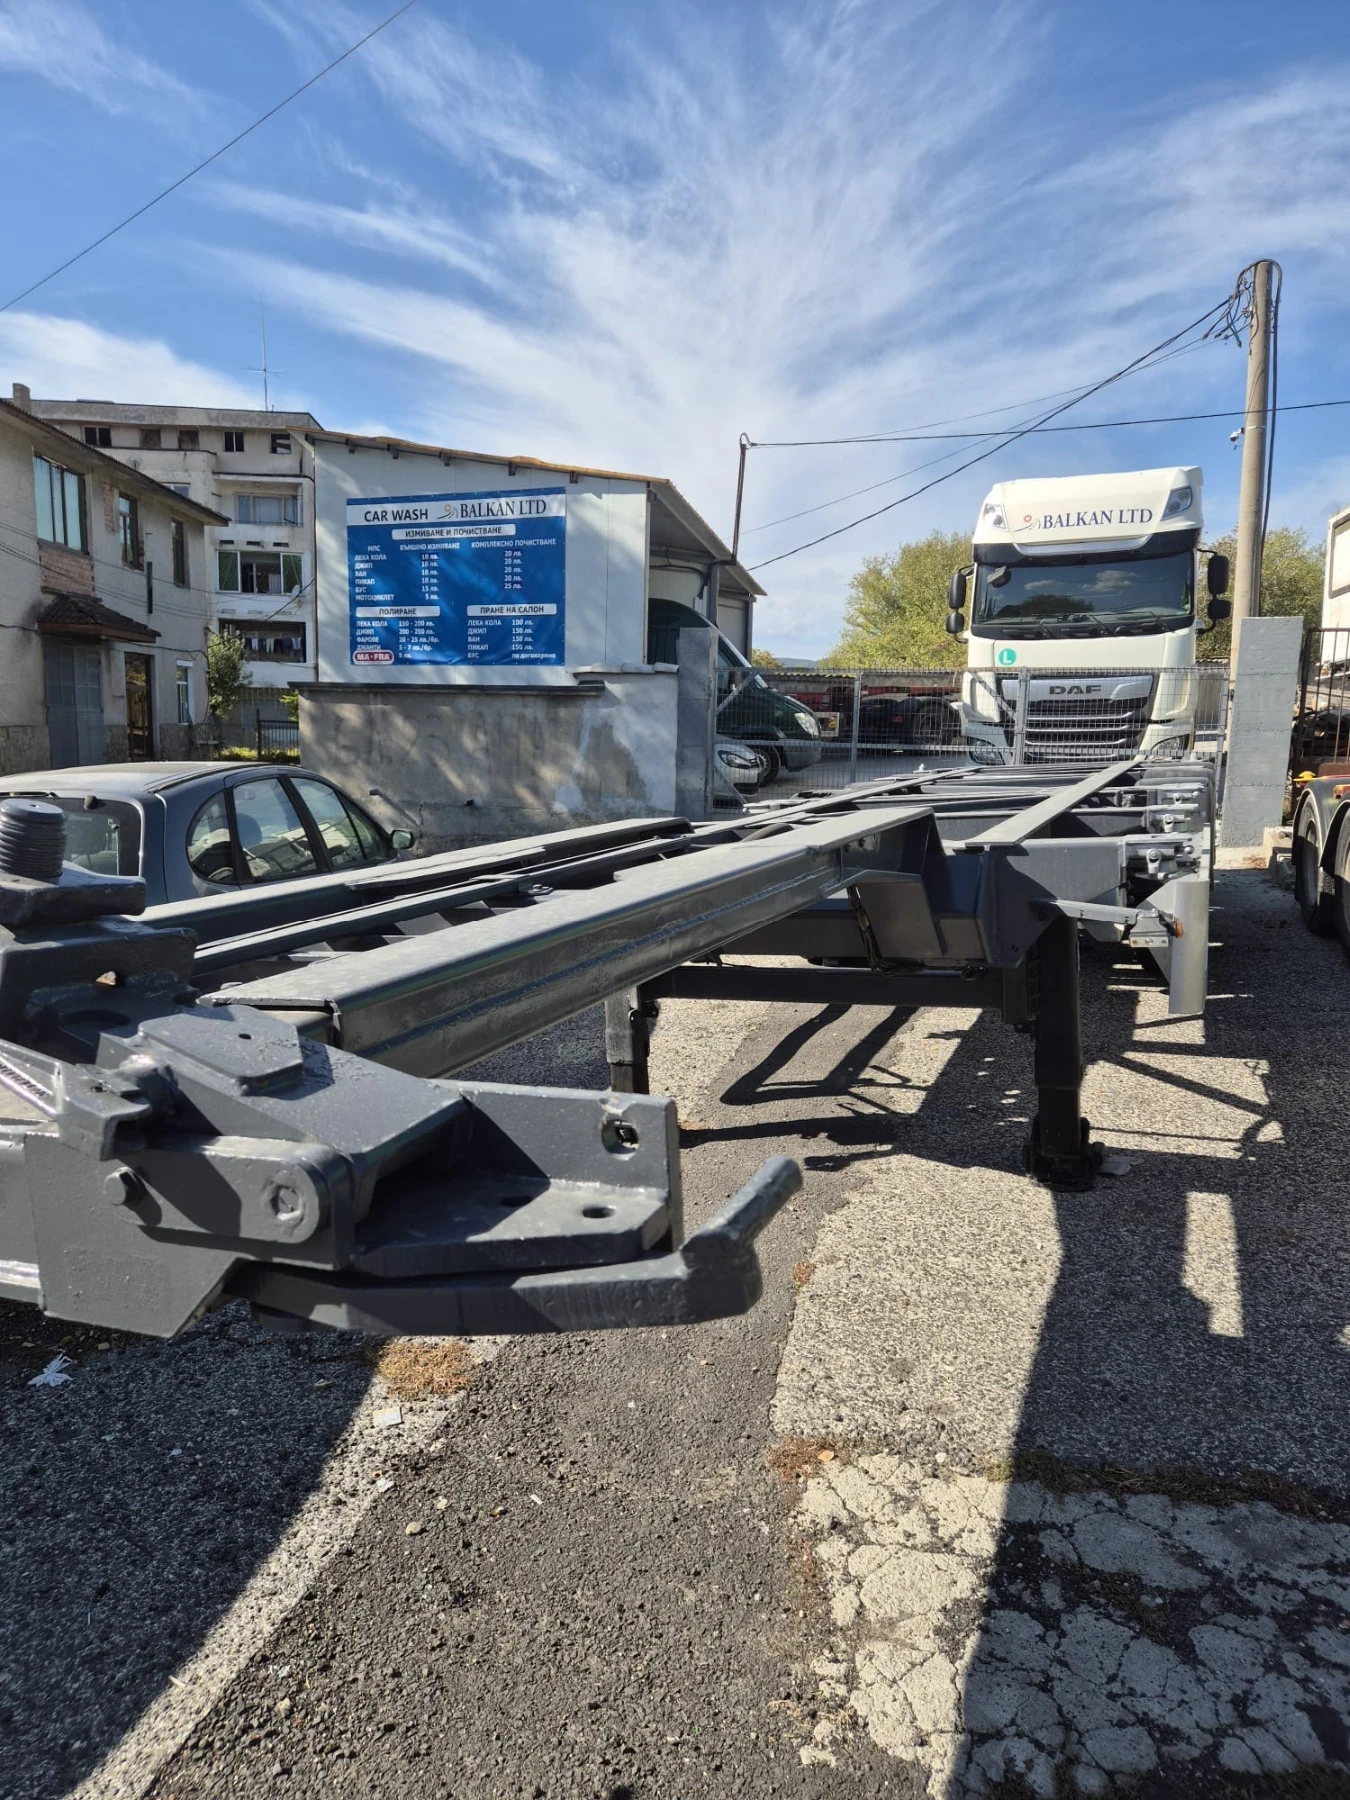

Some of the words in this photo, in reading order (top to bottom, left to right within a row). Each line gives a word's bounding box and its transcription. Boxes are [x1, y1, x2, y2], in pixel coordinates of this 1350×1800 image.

[460, 501, 515, 518] BALKAN
[520, 499, 546, 514] LTD
[364, 510, 388, 522] CAR
[392, 509, 428, 521] WASH
[1043, 510, 1113, 529] BALKAN
[1119, 508, 1152, 524] LTD
[454, 527, 502, 535] ПОЧИСТВАНЕ
[1003, 650, 1012, 664] L
[1049, 685, 1102, 695] DAF
